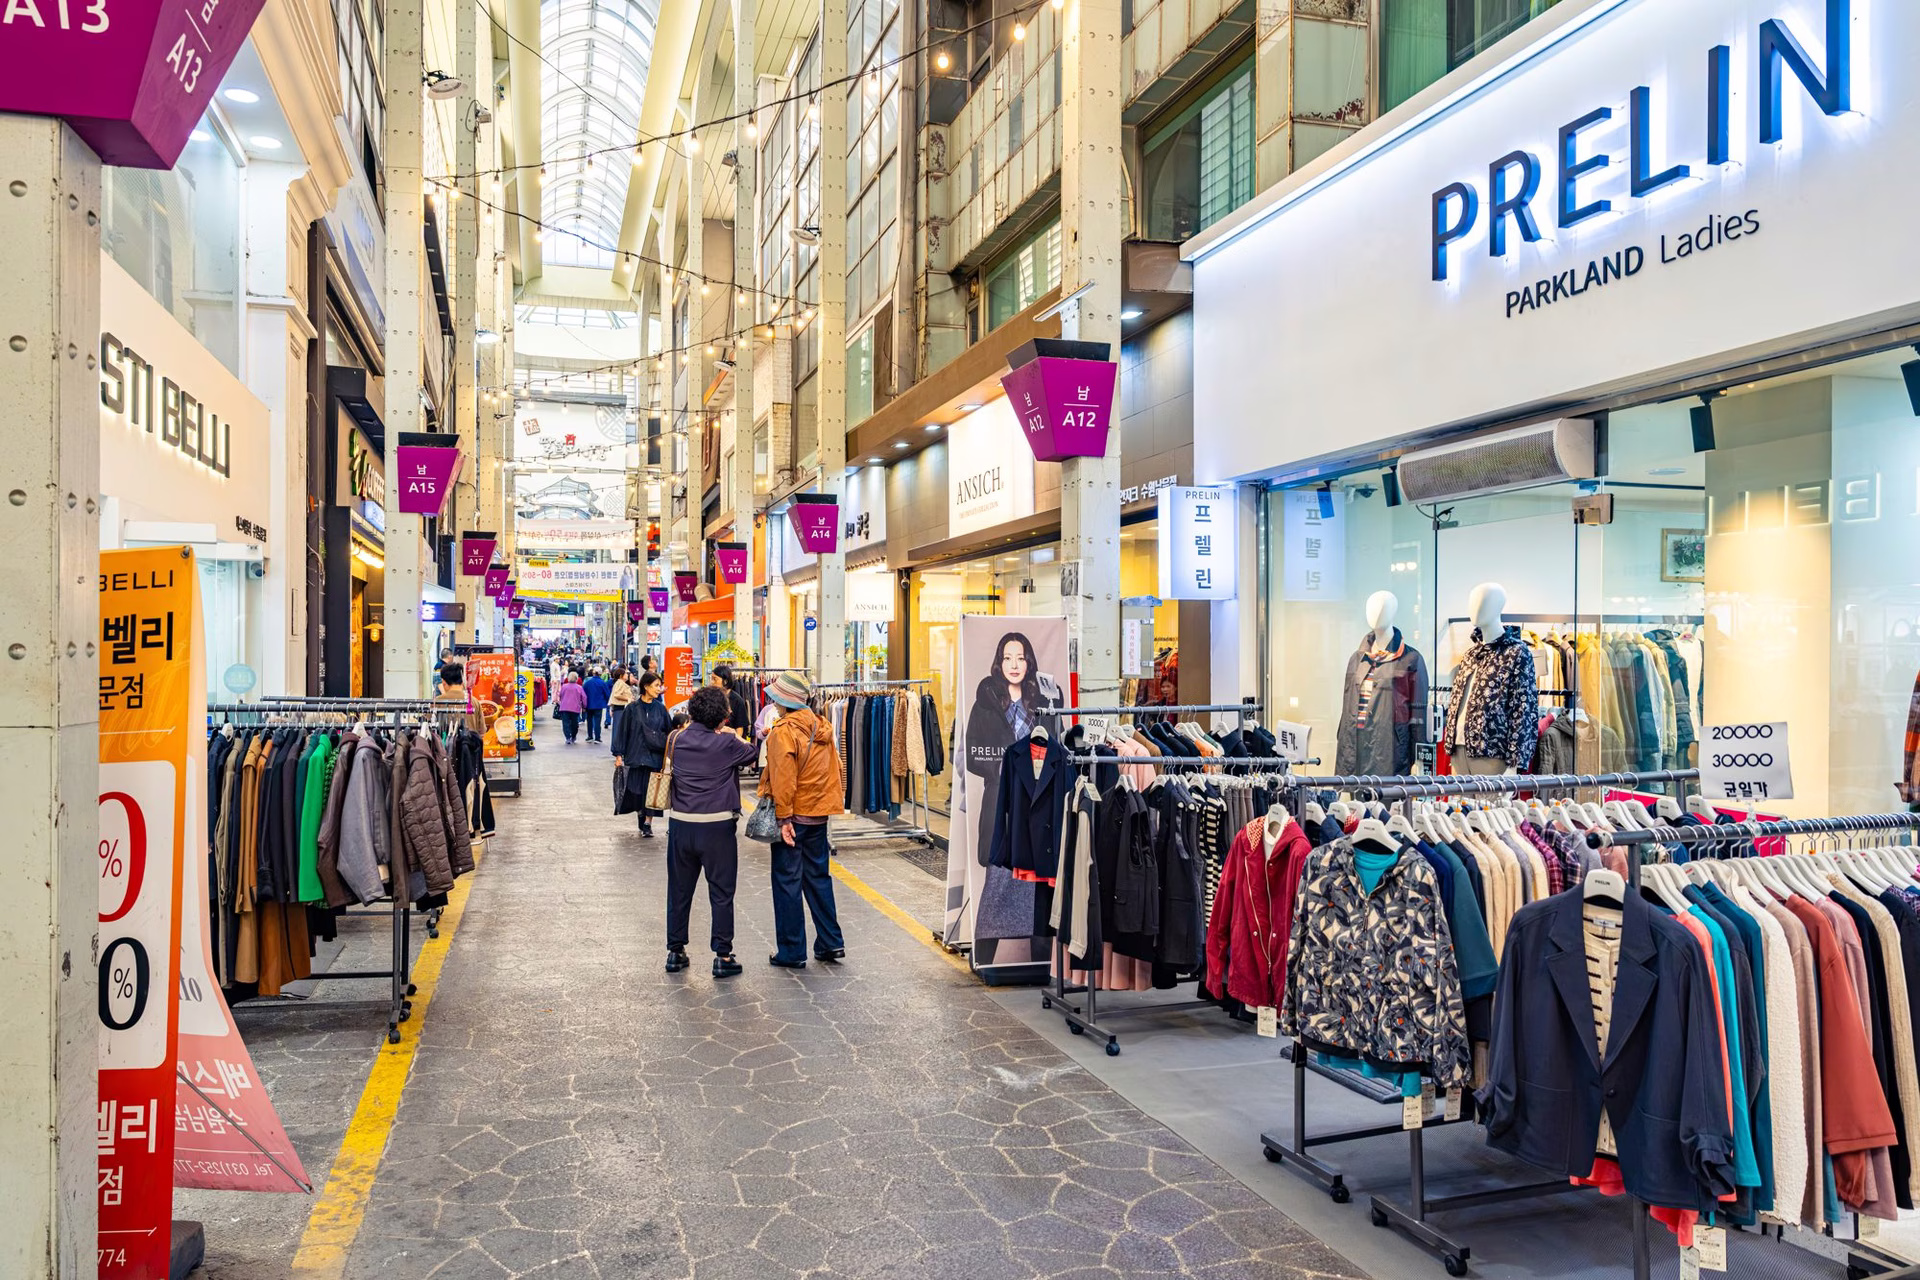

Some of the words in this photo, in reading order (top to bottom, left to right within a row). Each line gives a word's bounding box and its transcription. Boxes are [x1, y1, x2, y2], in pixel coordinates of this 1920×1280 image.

[166, 33, 203, 94] A13
[1432, 0, 1850, 281] PRELIN
[1505, 245, 1643, 318] PARKLAND
[1660, 209, 1760, 264] Ladies
[1078, 385, 1090, 401] 남
[161, 376, 230, 479] BELLI
[1028, 414, 1045, 434] A12
[1062, 411, 1096, 428] A12
[416, 464, 427, 476] 남
[408, 481, 436, 494] A15
[956, 466, 1001, 506] ANSICH
[1185, 490, 1221, 501] PRELIN
[811, 529, 830, 539] A14
[1194, 505, 1212, 589] 프렐린
[468, 558, 484, 566] A17
[728, 567, 742, 575] A16
[854, 603, 887, 611] ANSICH
[103, 611, 174, 665] 벨리
[1712, 724, 1773, 740] 20000
[1712, 753, 1773, 768] 30000
[1724, 781, 1768, 798] 균일가
